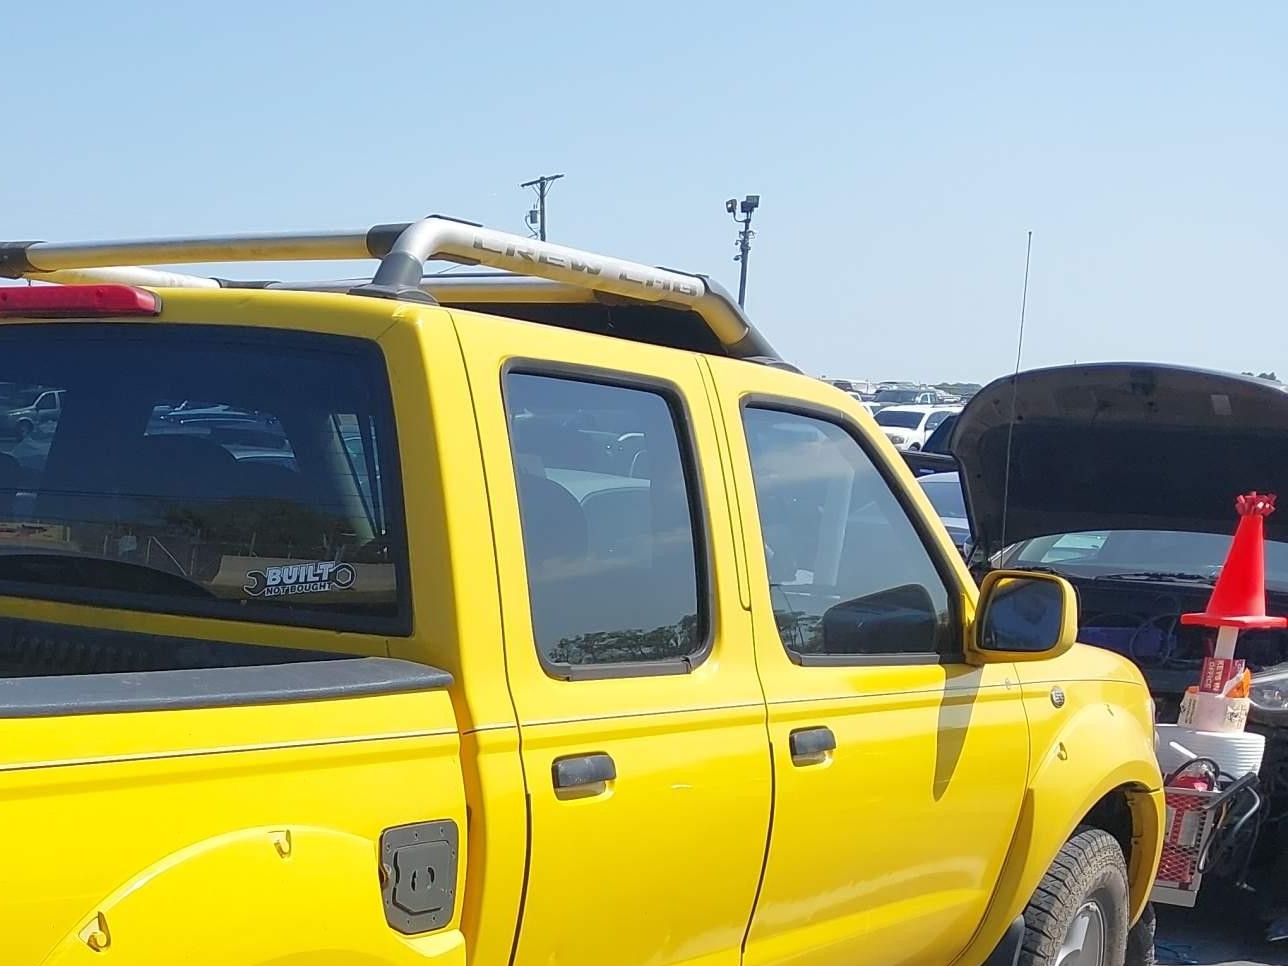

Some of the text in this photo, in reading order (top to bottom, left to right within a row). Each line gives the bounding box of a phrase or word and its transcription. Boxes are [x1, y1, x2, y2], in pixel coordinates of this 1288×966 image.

[267, 561, 335, 587] BUILT
[265, 582, 333, 597] NOT BOUGHT
